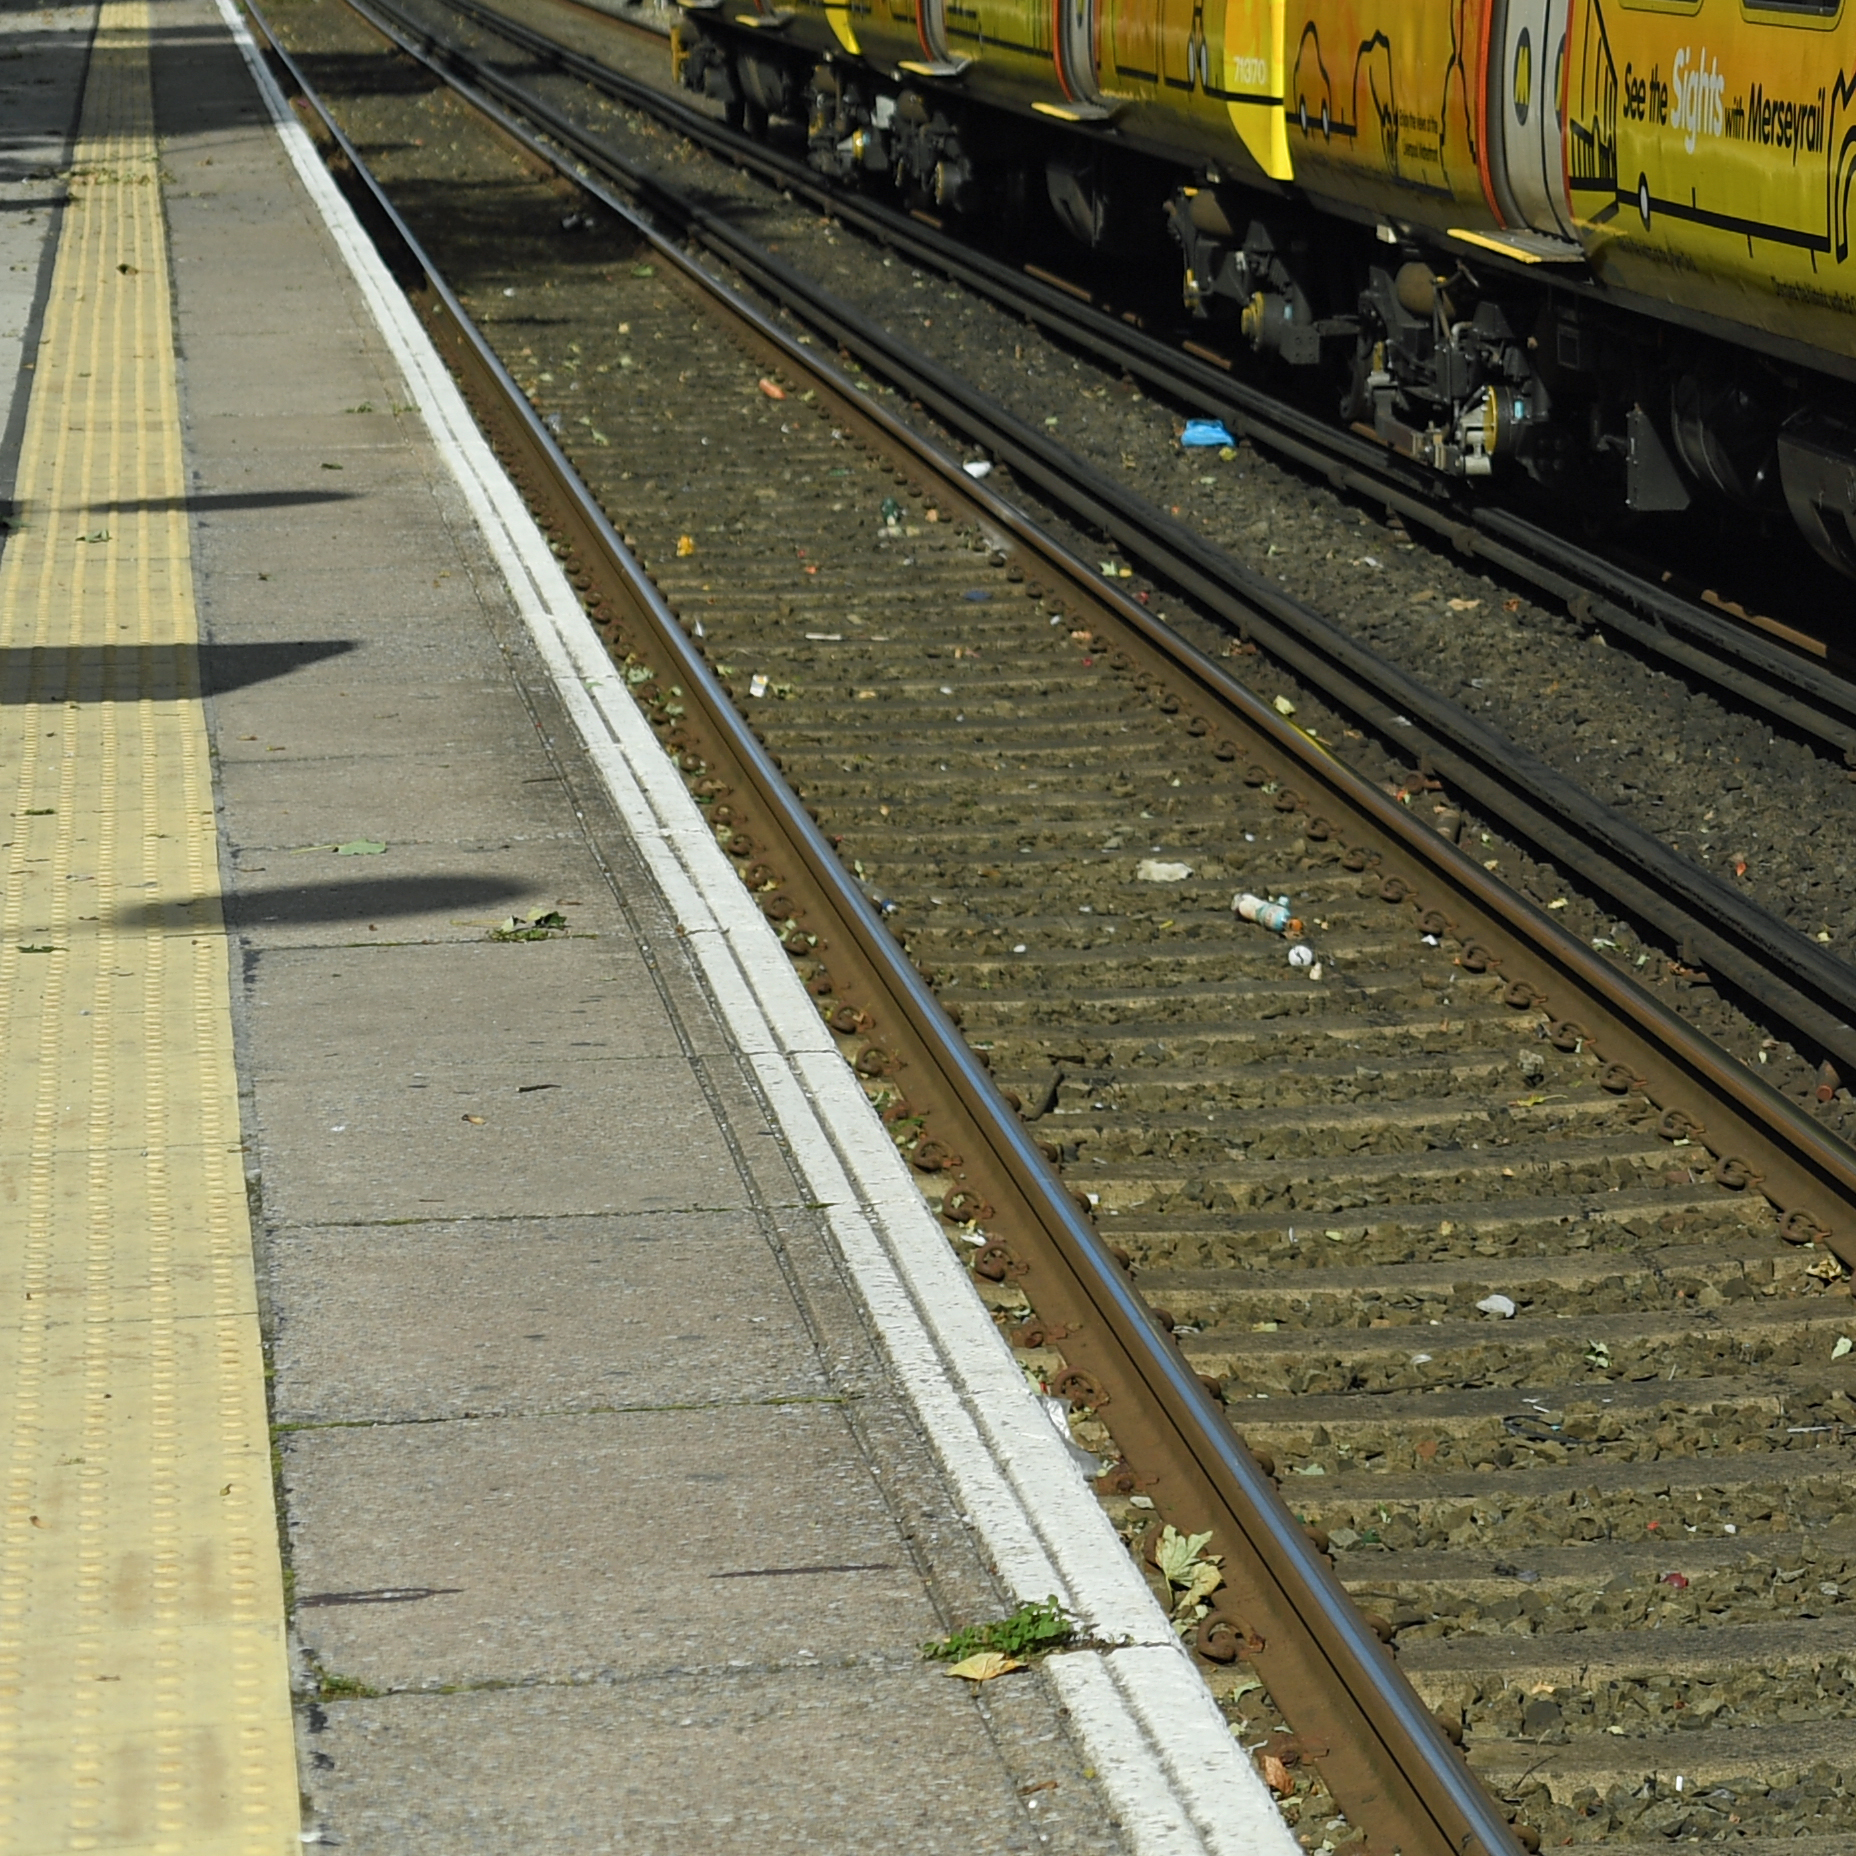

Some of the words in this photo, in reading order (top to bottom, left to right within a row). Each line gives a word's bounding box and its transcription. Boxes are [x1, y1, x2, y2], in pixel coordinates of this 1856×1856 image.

[1233, 55, 1267, 85] 71370
[1623, 61, 1646, 121] See
[1650, 63, 1668, 126] the
[1671, 46, 1725, 155] Sights
[1724, 95, 1745, 141] with
[1747, 82, 1826, 167] Merseyrail
